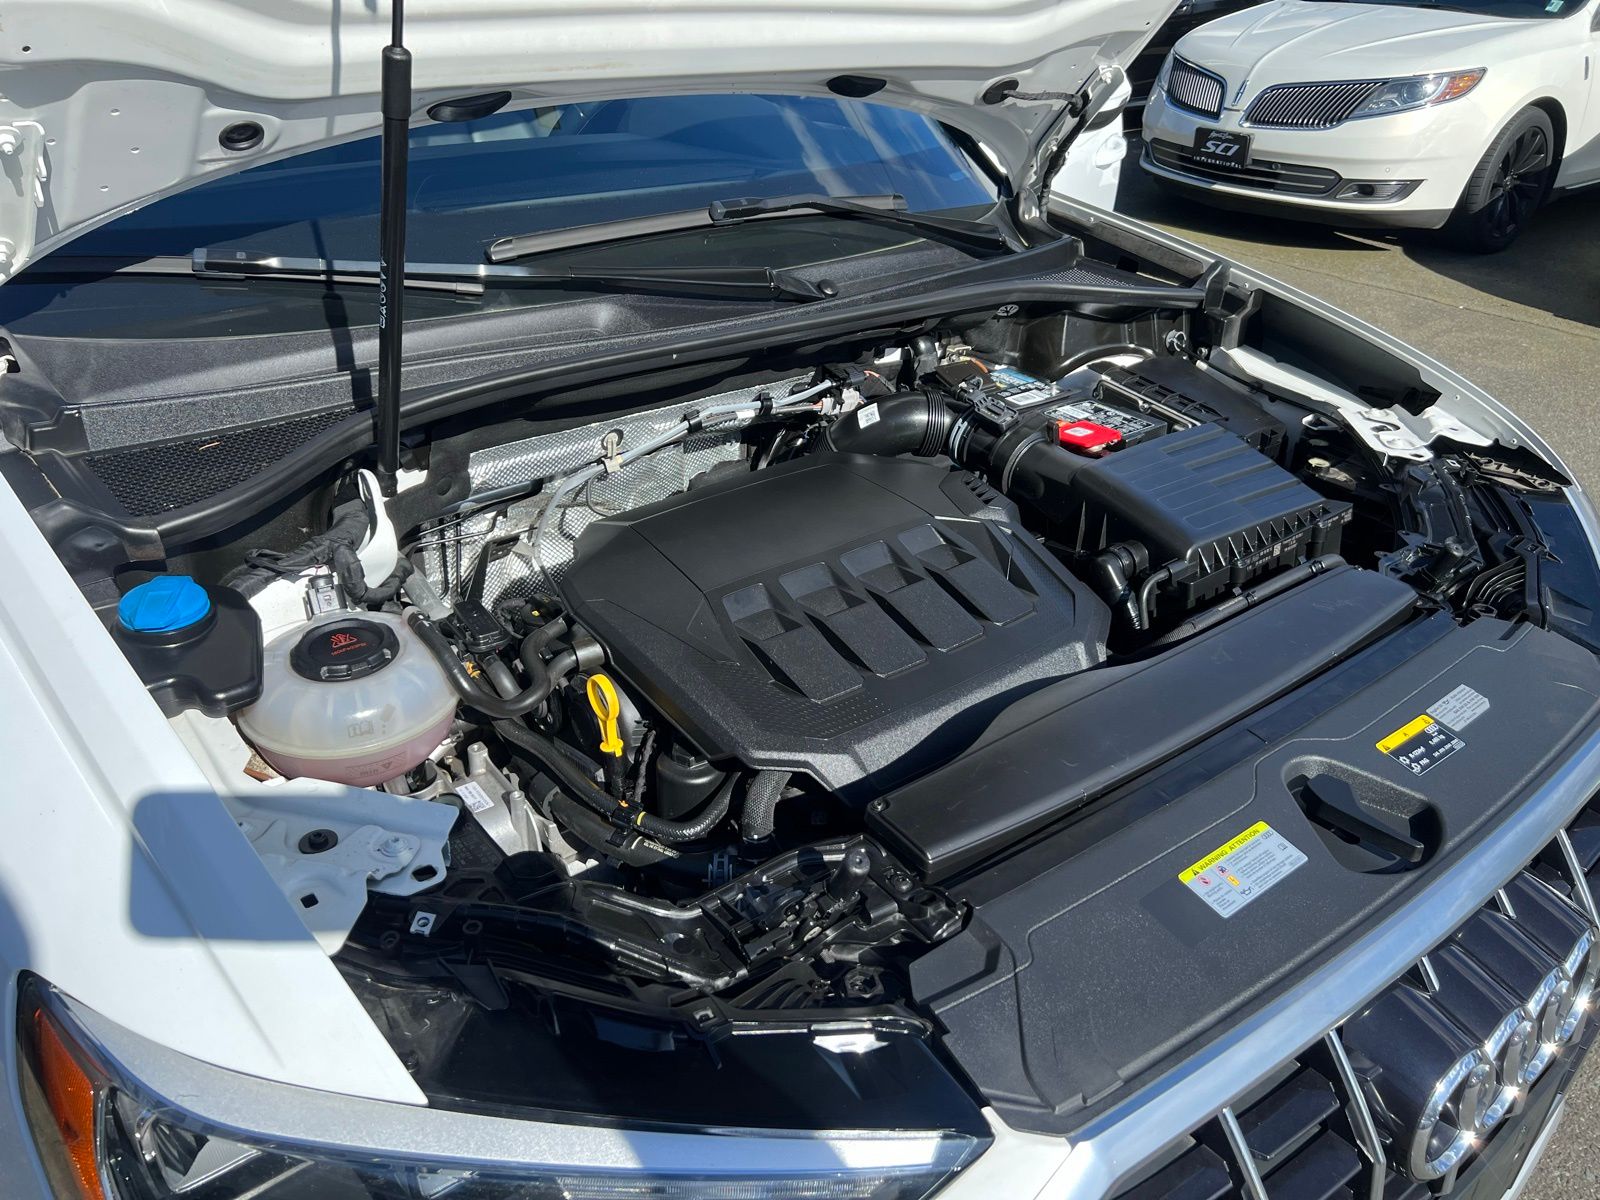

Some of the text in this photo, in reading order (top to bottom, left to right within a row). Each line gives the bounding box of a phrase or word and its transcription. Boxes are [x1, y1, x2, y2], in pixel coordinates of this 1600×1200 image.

[1200, 140, 1240, 156] SCI
[1199, 849, 1228, 871] WARNING
[1228, 828, 1260, 852] ATTENTION
